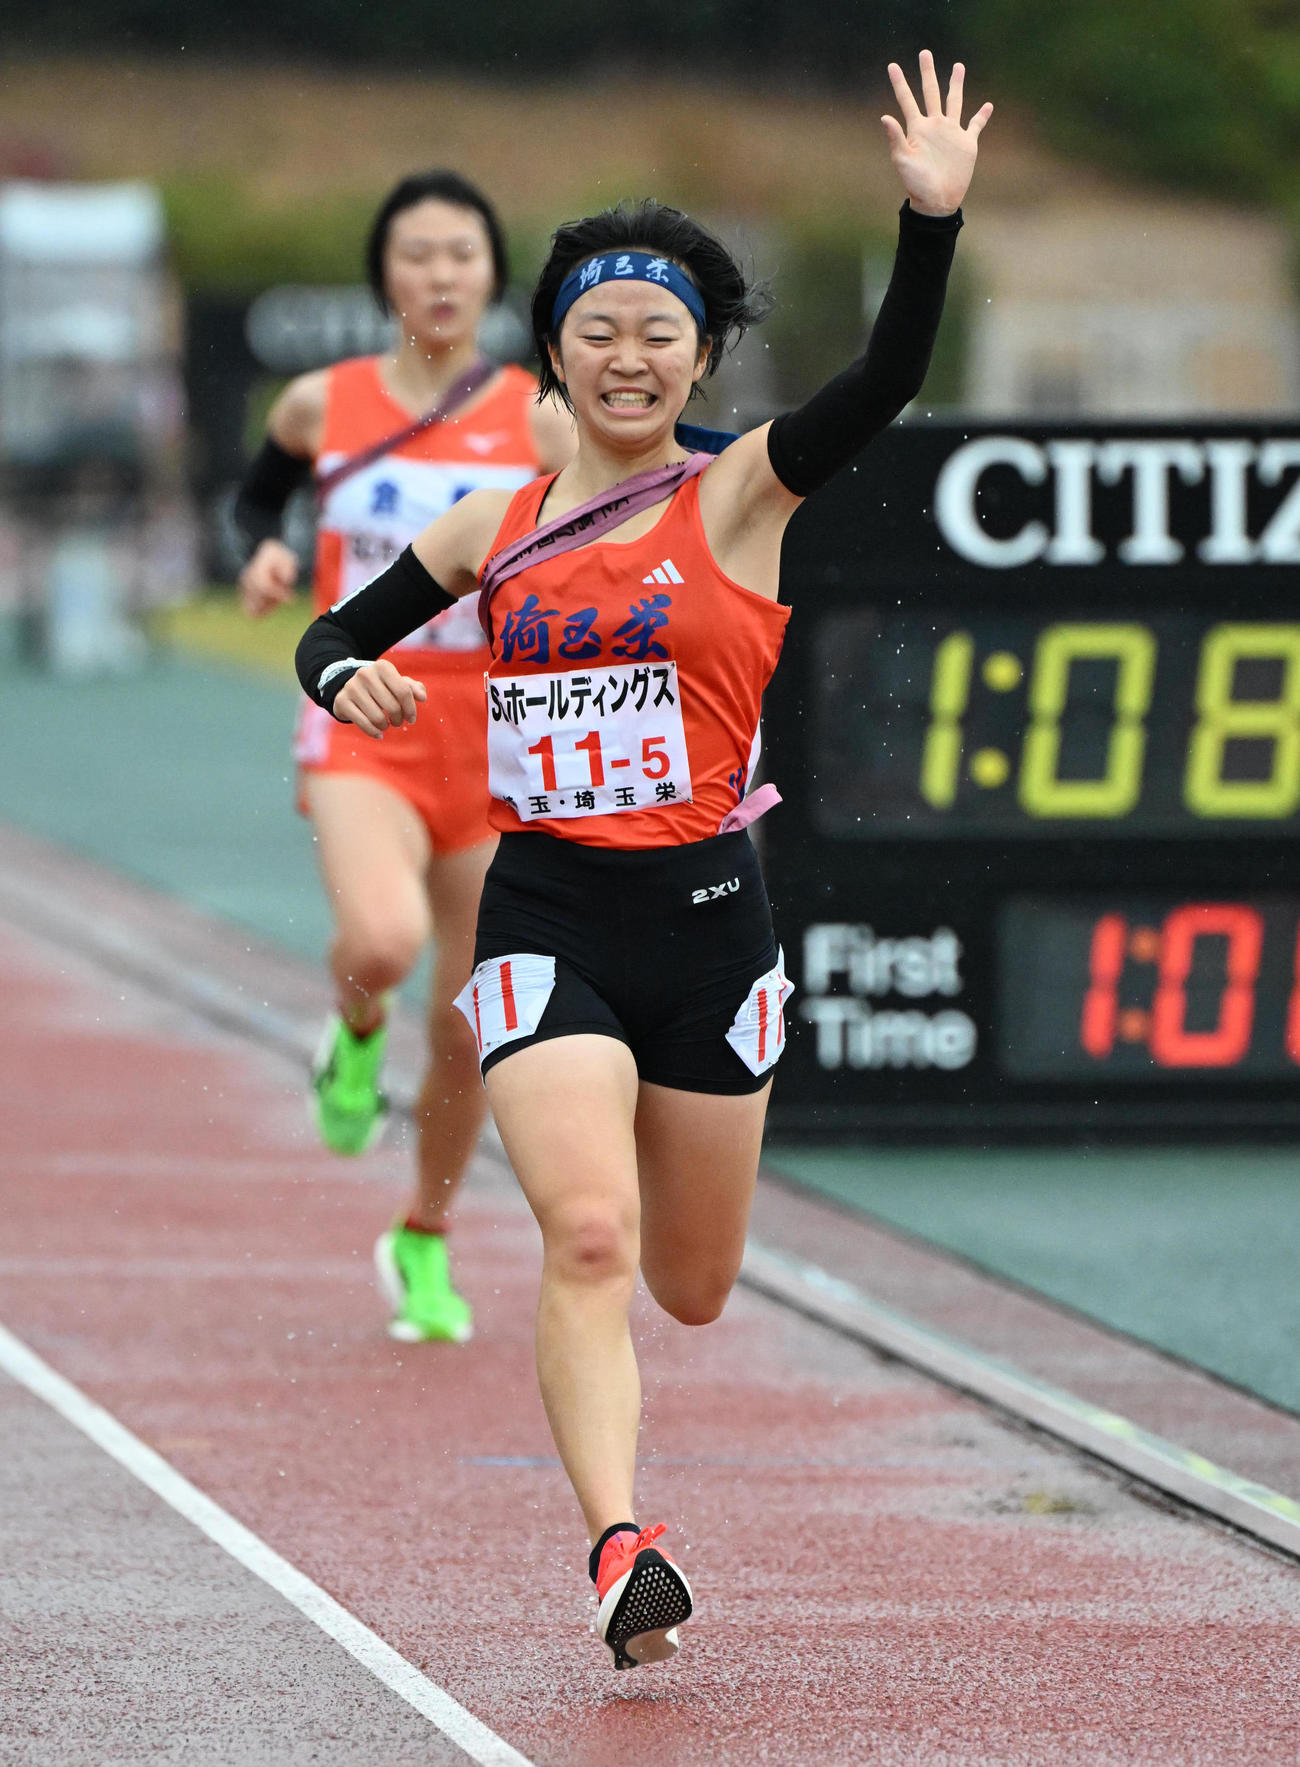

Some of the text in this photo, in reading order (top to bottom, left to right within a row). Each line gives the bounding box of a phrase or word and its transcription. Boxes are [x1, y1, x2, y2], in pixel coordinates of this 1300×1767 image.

[501, 594, 671, 663] 埼玉栄
[490, 667, 675, 725] Sホールディングス
[527, 730, 671, 792] 11-5
[691, 877, 740, 904] 2XU
[803, 922, 963, 996] First
[805, 998, 977, 1070] Time
